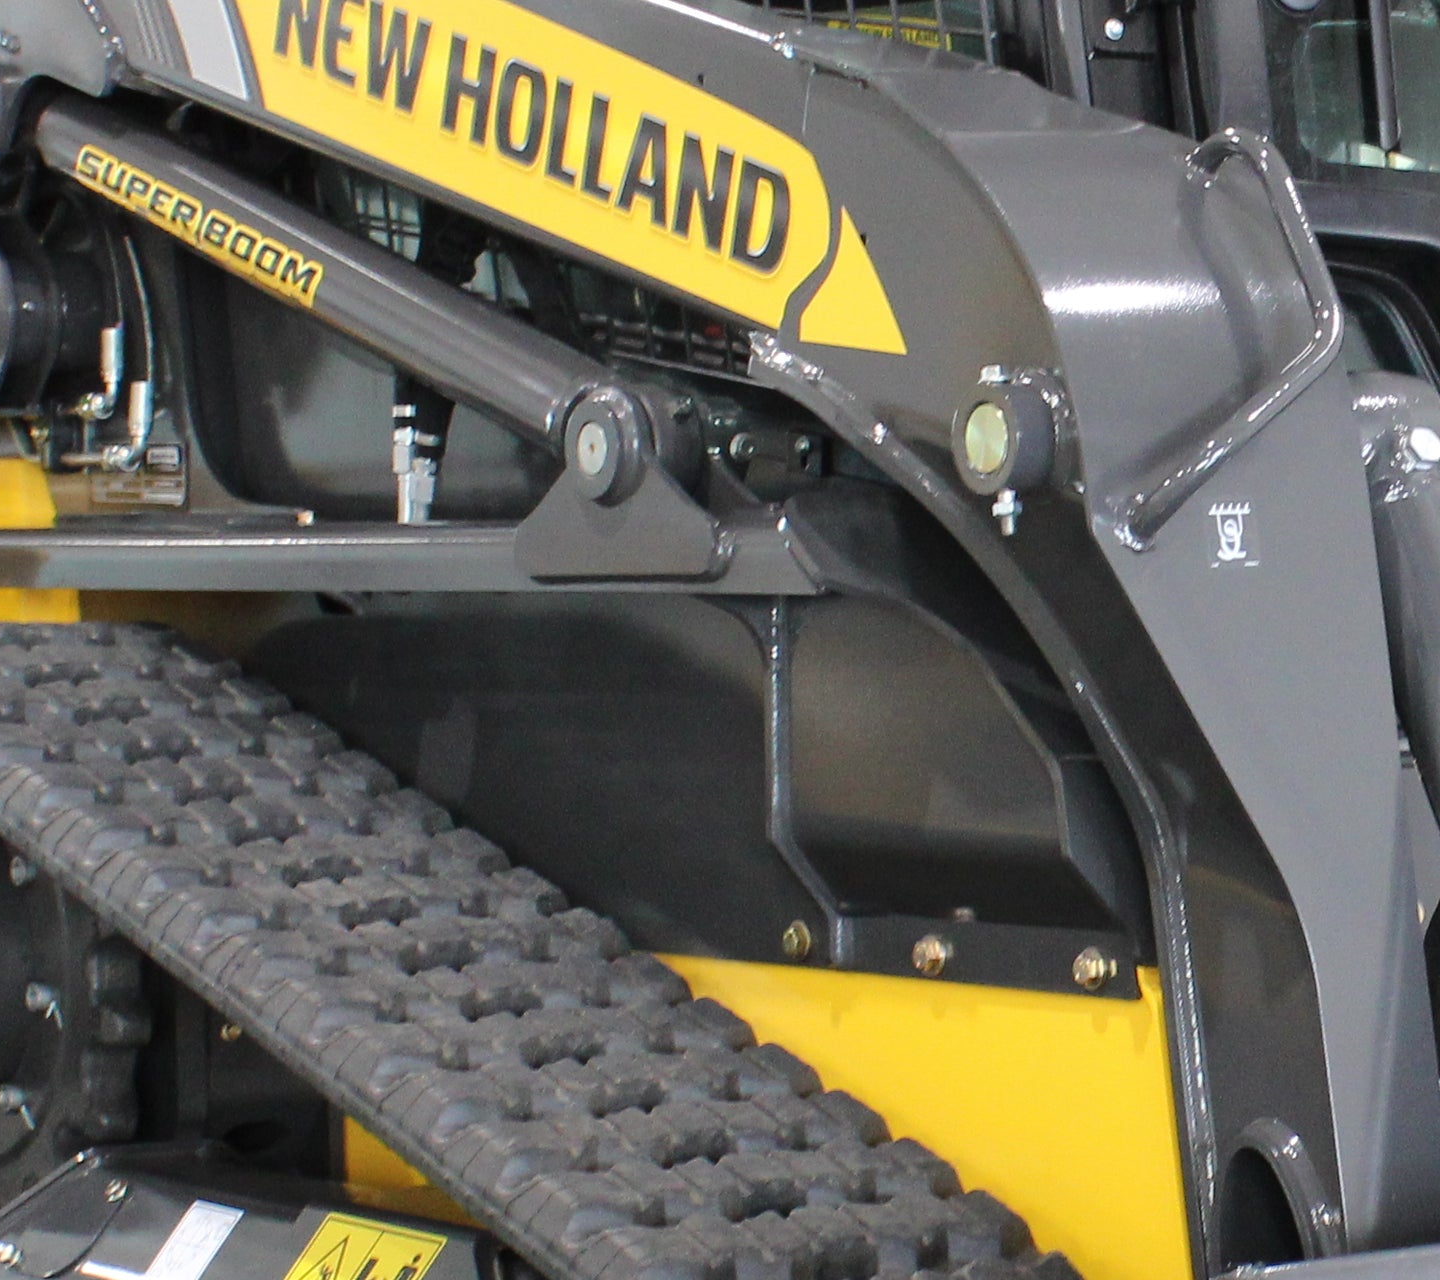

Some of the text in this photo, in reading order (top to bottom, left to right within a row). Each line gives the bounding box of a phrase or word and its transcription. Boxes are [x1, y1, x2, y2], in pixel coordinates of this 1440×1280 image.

[78, 148, 318, 295] SUPER BOOM
[440, 32, 790, 276] HOLLAND
